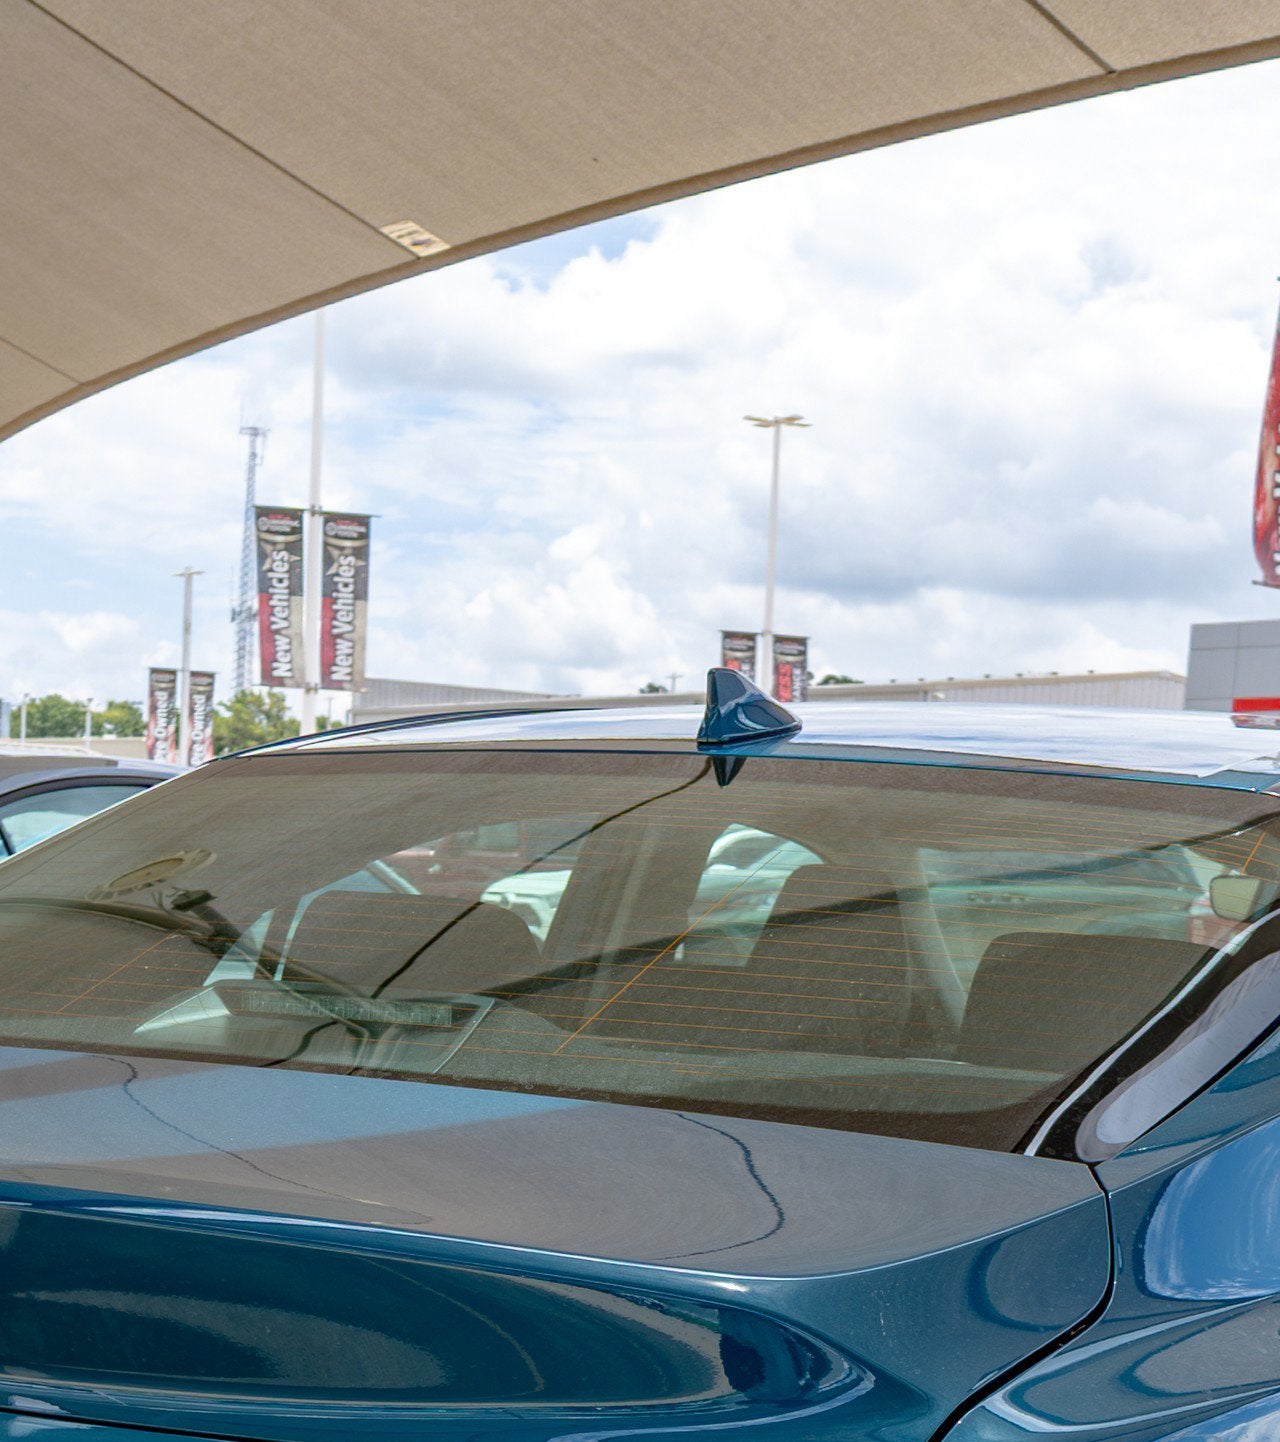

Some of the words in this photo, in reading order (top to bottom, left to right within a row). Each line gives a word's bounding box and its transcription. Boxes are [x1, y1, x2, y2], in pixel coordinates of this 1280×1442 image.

[269, 550, 290, 630] Vehicles
[331, 555, 357, 635] Vehicles
[272, 636, 292, 677] New
[331, 639, 354, 681] New
